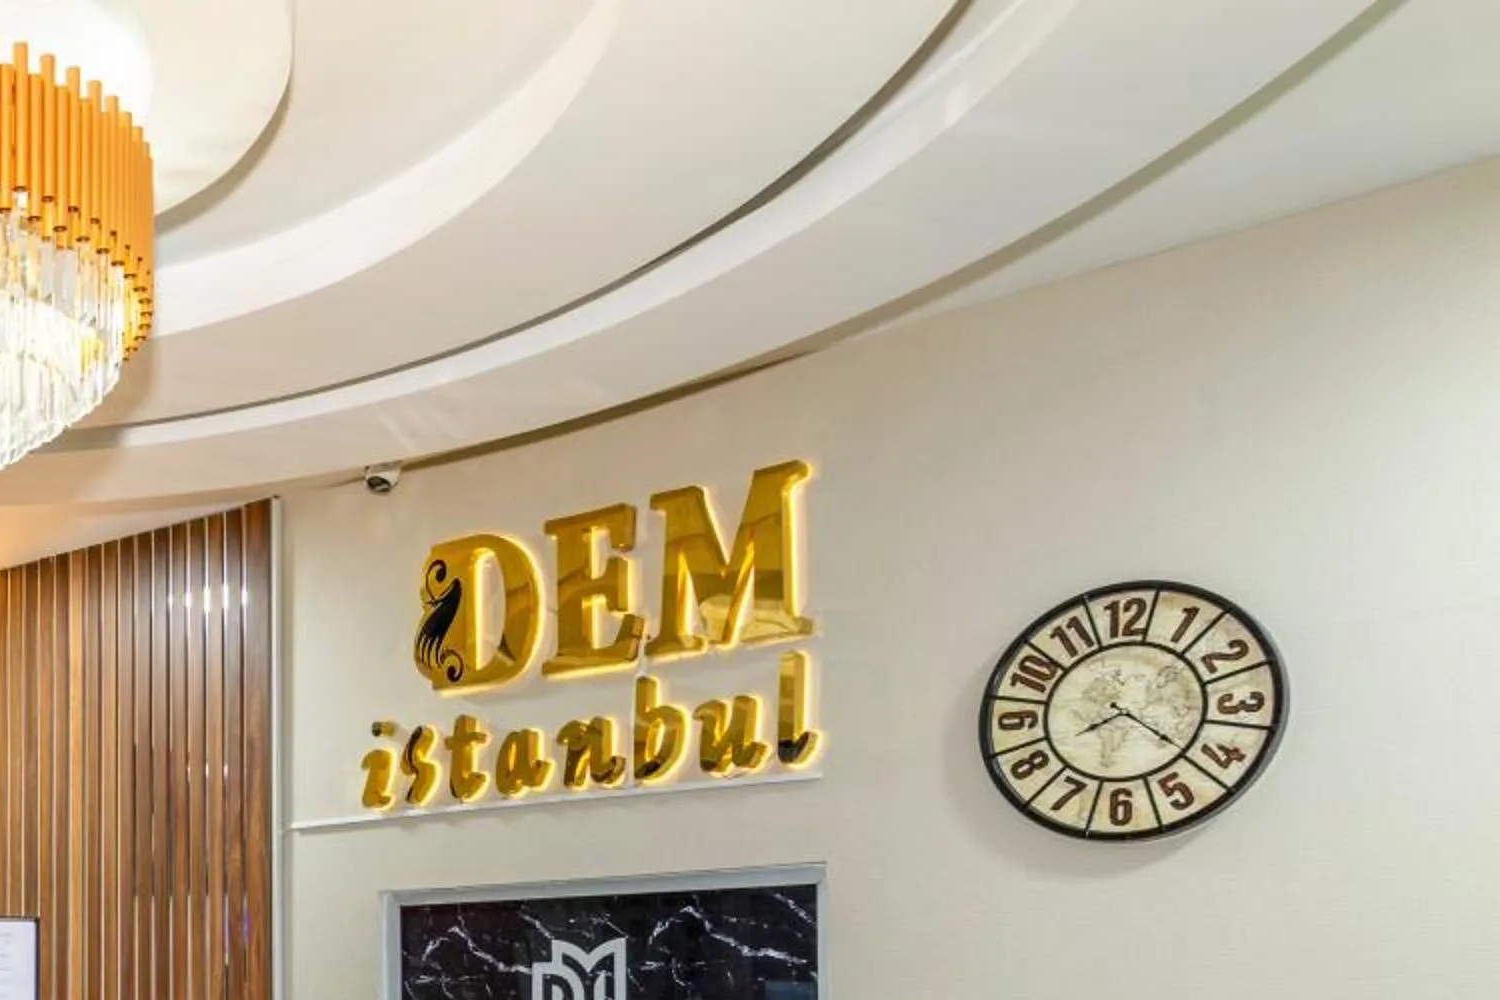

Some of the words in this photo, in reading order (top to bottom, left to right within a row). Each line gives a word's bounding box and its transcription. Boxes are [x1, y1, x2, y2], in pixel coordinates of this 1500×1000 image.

[413, 459, 815, 696] DEM
[1050, 615, 1095, 658] 11
[1104, 597, 1148, 639] 12
[1170, 605, 1200, 644] 1
[1010, 654, 1058, 694] 10
[1201, 638, 1249, 675] 2
[997, 709, 1039, 731] 9
[1216, 691, 1265, 715] 3
[361, 650, 821, 810] istanbul
[1010, 749, 1050, 781] 8
[1201, 743, 1247, 770] 4
[1050, 775, 1088, 812] 7
[1109, 788, 1133, 827] 6
[1157, 772, 1195, 811] 5
